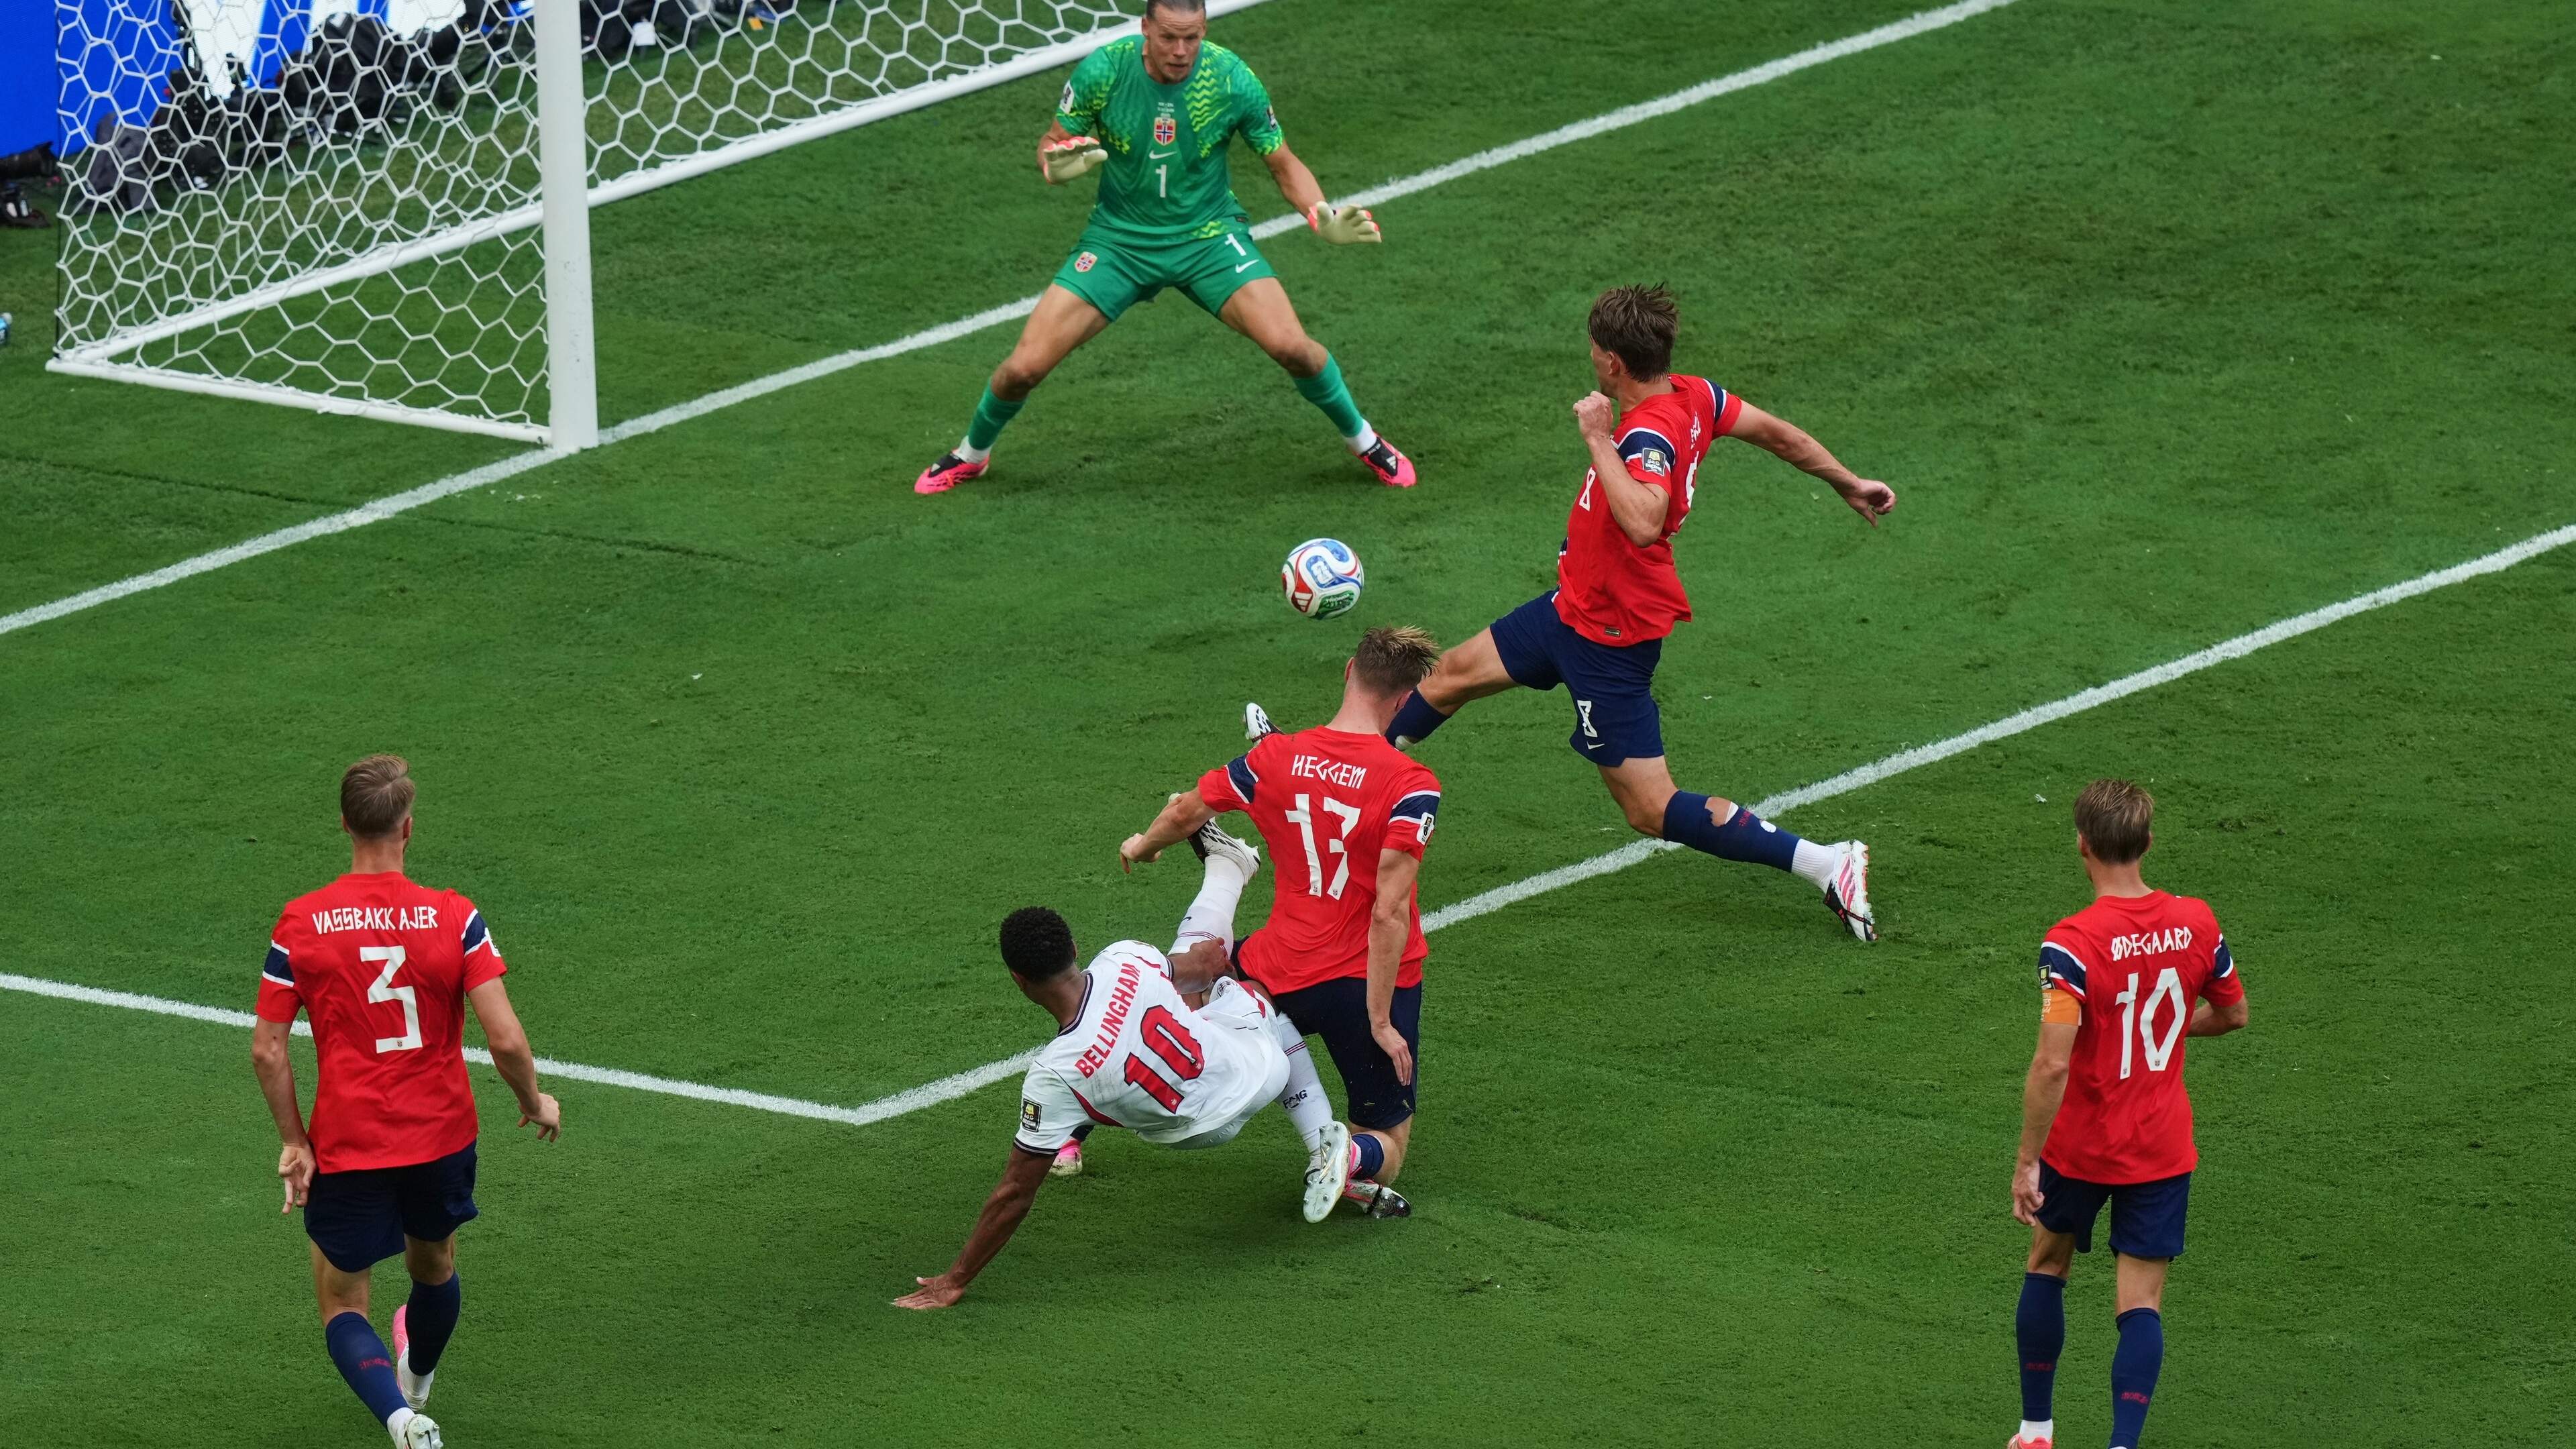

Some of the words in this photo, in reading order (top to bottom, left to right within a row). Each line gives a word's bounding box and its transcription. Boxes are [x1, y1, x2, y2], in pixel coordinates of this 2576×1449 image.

[1155, 164, 1167, 198] 1
[1225, 233, 1247, 256] 1
[1578, 466, 1597, 512] 8
[1576, 700, 1598, 738] 8
[1291, 754, 1367, 790] HEGGEM
[1285, 794, 1361, 901] 13
[312, 906, 396, 934] VASSBAKK
[399, 906, 438, 930] AJER
[2110, 926, 2192, 961] ØDEGAARD
[359, 945, 423, 1054] 3
[1075, 963, 1141, 1079] BELLINGHAM
[2115, 967, 2187, 1079] 10
[1124, 1004, 1205, 1114] 10
